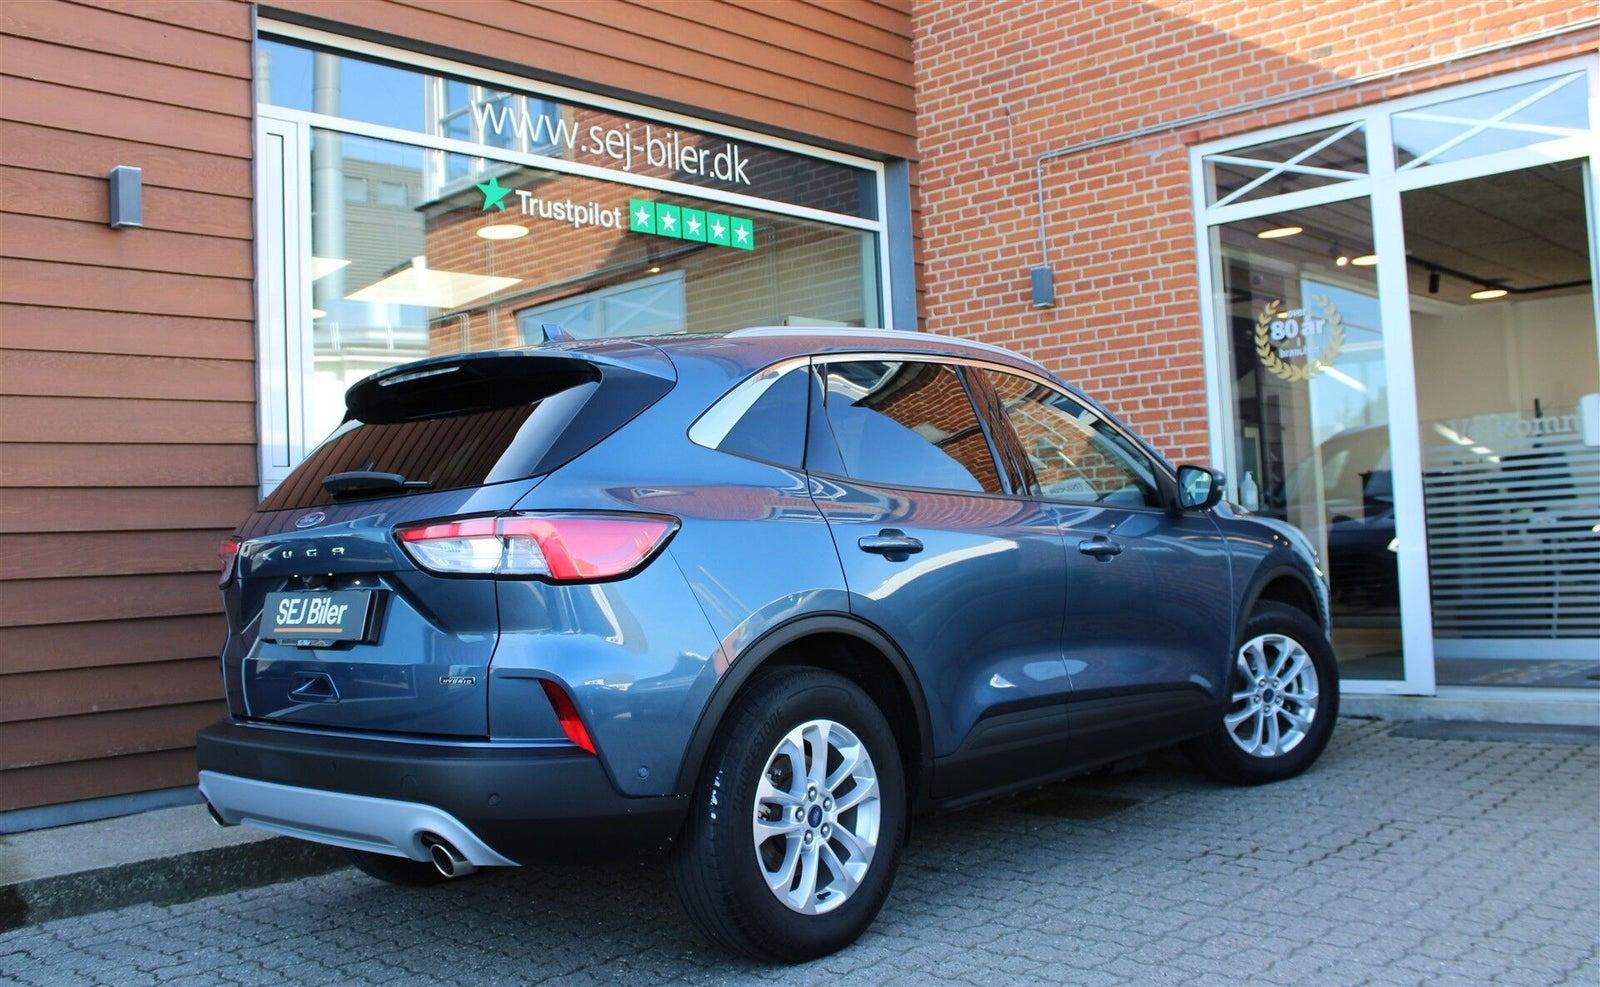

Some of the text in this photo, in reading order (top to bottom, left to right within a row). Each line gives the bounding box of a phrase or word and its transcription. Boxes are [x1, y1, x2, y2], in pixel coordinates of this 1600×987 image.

[470, 99, 752, 186] www.sej-biler.dk
[515, 189, 623, 230] Trustpilot
[1270, 319, 1298, 340] 80
[262, 546, 345, 561] KUGA
[276, 597, 349, 625] SEJ Biler
